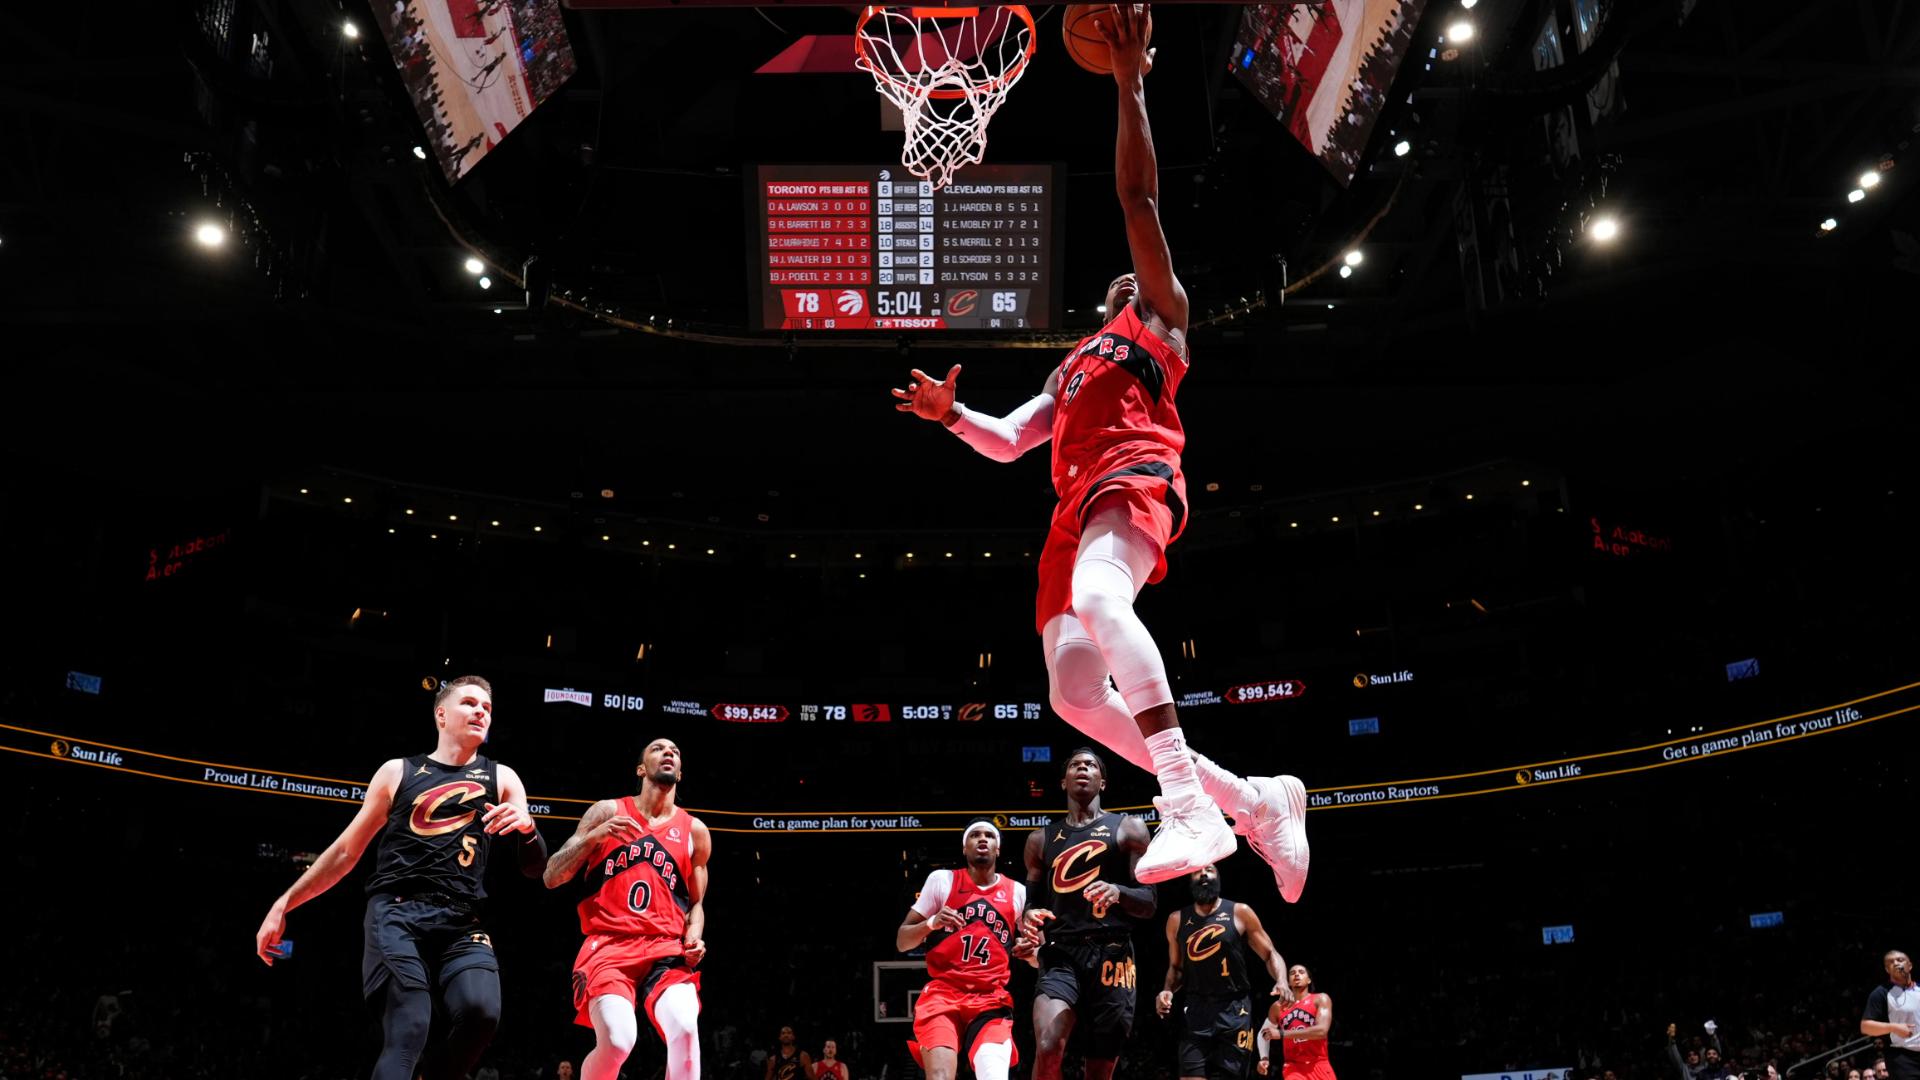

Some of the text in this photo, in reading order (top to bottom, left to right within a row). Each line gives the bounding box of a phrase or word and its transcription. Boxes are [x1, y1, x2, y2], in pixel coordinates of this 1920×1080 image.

[768, 186, 816, 194] TORONTO
[819, 186, 831, 194] PTS
[882, 185, 888, 194] 6
[923, 185, 929, 194] 9
[944, 186, 993, 194] CLEVELAND
[994, 186, 1005, 194] PTS
[786, 202, 818, 211] LAWSON
[822, 202, 828, 211] 3
[834, 202, 841, 211] 0
[847, 202, 853, 211] 0
[860, 202, 866, 211] 0
[880, 204, 891, 212] 15
[920, 204, 932, 212] 20
[960, 203, 1027, 212] HARDEN 8 5 5
[787, 221, 818, 229] BARRETT
[821, 221, 831, 229] 18
[835, 221, 841, 229] 7
[848, 221, 853, 229] 3
[860, 221, 866, 229] 3
[880, 221, 891, 230] 18
[921, 221, 931, 230] 14
[943, 220, 1027, 229] 4 MOBLEY 17 7 2
[769, 238, 778, 247] 12
[823, 238, 829, 247] 7
[835, 238, 841, 247] 4
[860, 238, 867, 247] 2
[880, 238, 891, 247] 10
[923, 238, 929, 247] 5
[943, 238, 1038, 246] 5 MERRILL 2 3
[770, 256, 867, 264] 14 WALTER 19 0 3
[882, 256, 889, 264] 3
[924, 256, 930, 264] 2
[943, 256, 950, 264] 8
[995, 256, 1001, 264] 3
[1008, 256, 1014, 264] 0
[788, 272, 867, 281] POELTL 2 3 3
[880, 273, 892, 282] 20
[924, 273, 929, 282] 7
[941, 272, 1038, 281] 20 TYSON 5 3 3 2
[934, 293, 939, 303] 3
[992, 292, 1016, 312] 65
[795, 291, 922, 315] 78 5:04
[806, 319, 812, 328] 5
[894, 319, 938, 328] TISSOT
[1018, 319, 1023, 328] 3
[1066, 370, 1085, 405] 9
[1370, 670, 1413, 685] Sun Life
[1184, 691, 1213, 700] WINNER
[1238, 683, 1293, 702] $99,542
[670, 700, 700, 708] WINNER
[1200, 696, 1222, 704] HOME
[662, 706, 708, 716] TAKES HOME
[725, 706, 777, 720] $99,542
[823, 706, 846, 720] 78
[902, 706, 939, 720] 5:03
[994, 704, 1018, 718] 65
[810, 713, 816, 721] 5
[943, 712, 950, 720] 3
[1662, 707, 1863, 760] Get a game plan for your life.
[71, 746, 123, 766] Sun Life
[1534, 764, 1581, 781] Sun Life
[204, 767, 248, 786] Proud
[251, 774, 278, 789] Life
[281, 779, 348, 798] Insurance
[1311, 785, 1440, 806] the Toronto Raptors
[409, 780, 486, 836] C
[753, 816, 922, 832] Get a game plan for your life.
[1009, 815, 1051, 827] Sun Life
[458, 834, 476, 868] 5
[604, 842, 678, 890] RAPTORS
[1052, 840, 1108, 894] C
[627, 880, 652, 914] 0
[1186, 924, 1226, 962] C
[960, 934, 990, 966] 14
[1221, 958, 1230, 976] 1
